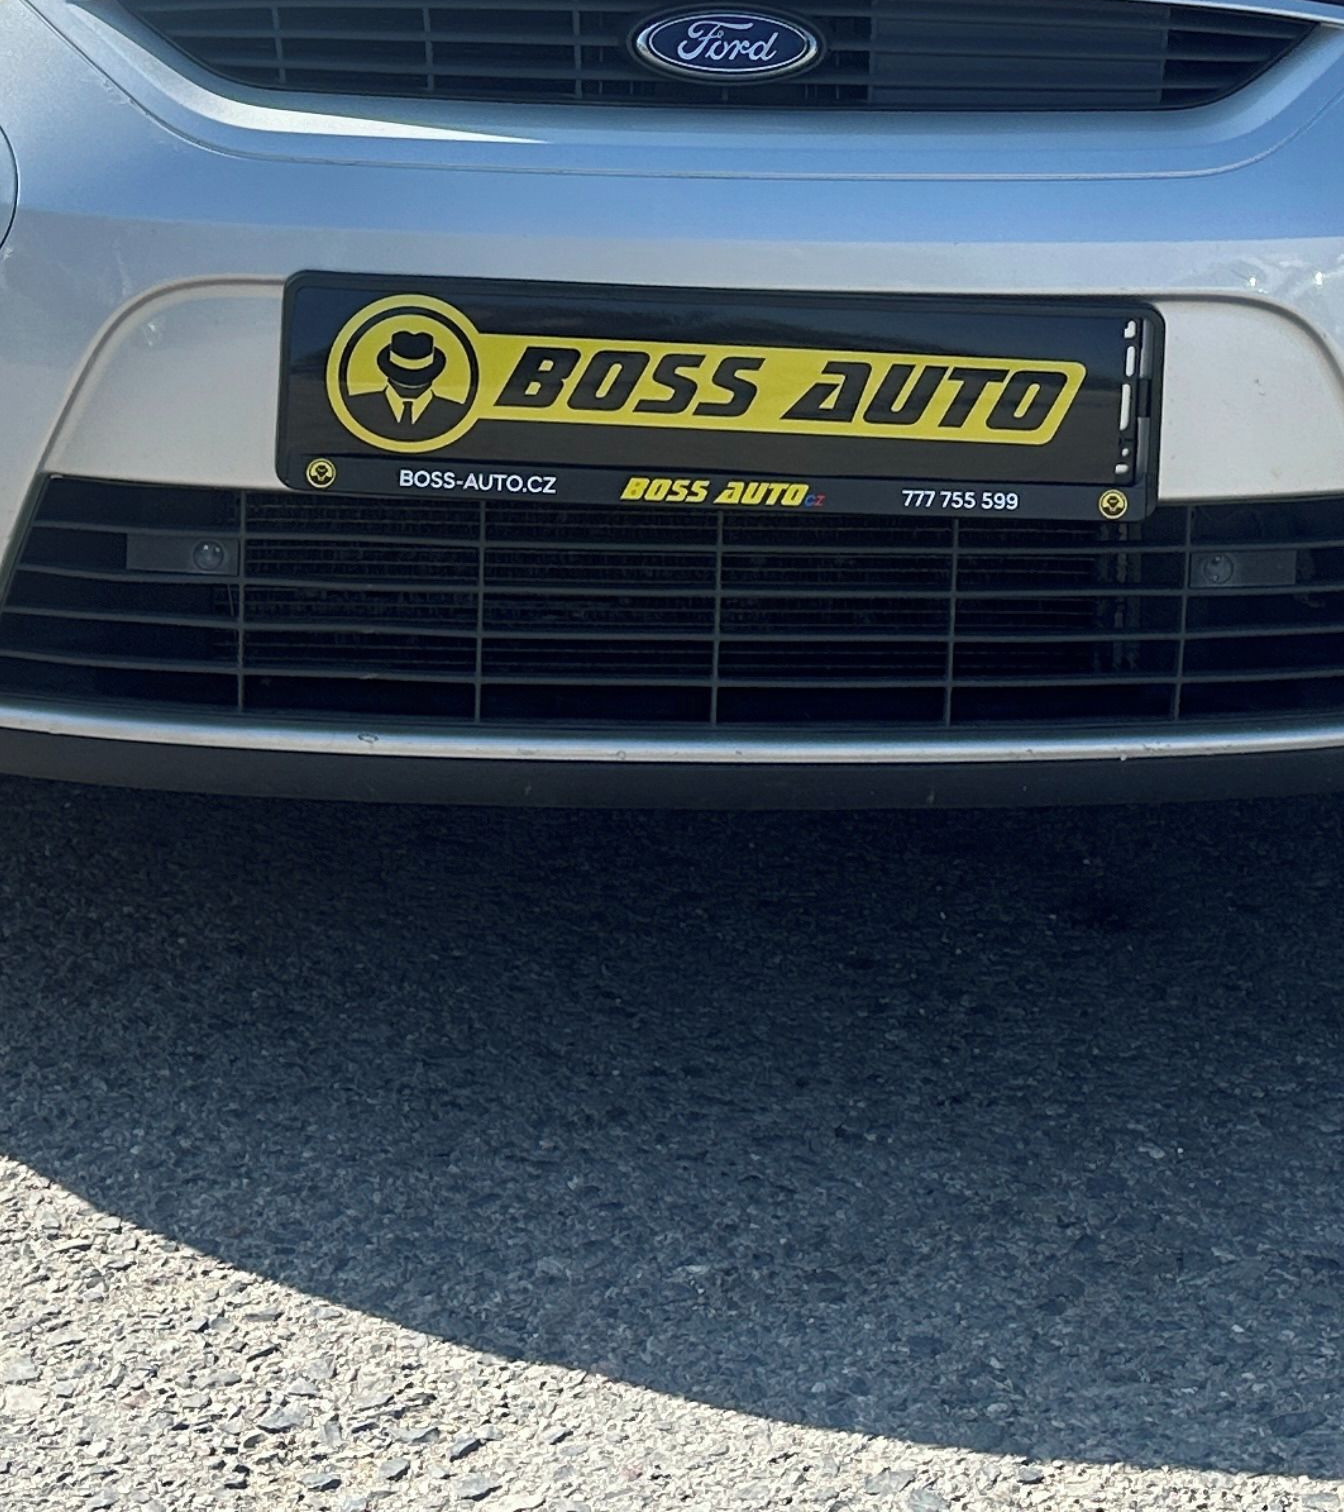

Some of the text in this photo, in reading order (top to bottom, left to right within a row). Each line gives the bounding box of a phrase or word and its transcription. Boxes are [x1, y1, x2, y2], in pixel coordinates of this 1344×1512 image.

[676, 19, 779, 61] Ford
[492, 345, 1069, 432] BOSS AUTO
[398, 468, 557, 495] BOSS-AUTO.CZ
[619, 477, 711, 503] BOSS
[712, 480, 810, 506] AUTO
[901, 489, 1019, 511] 777 755 599
